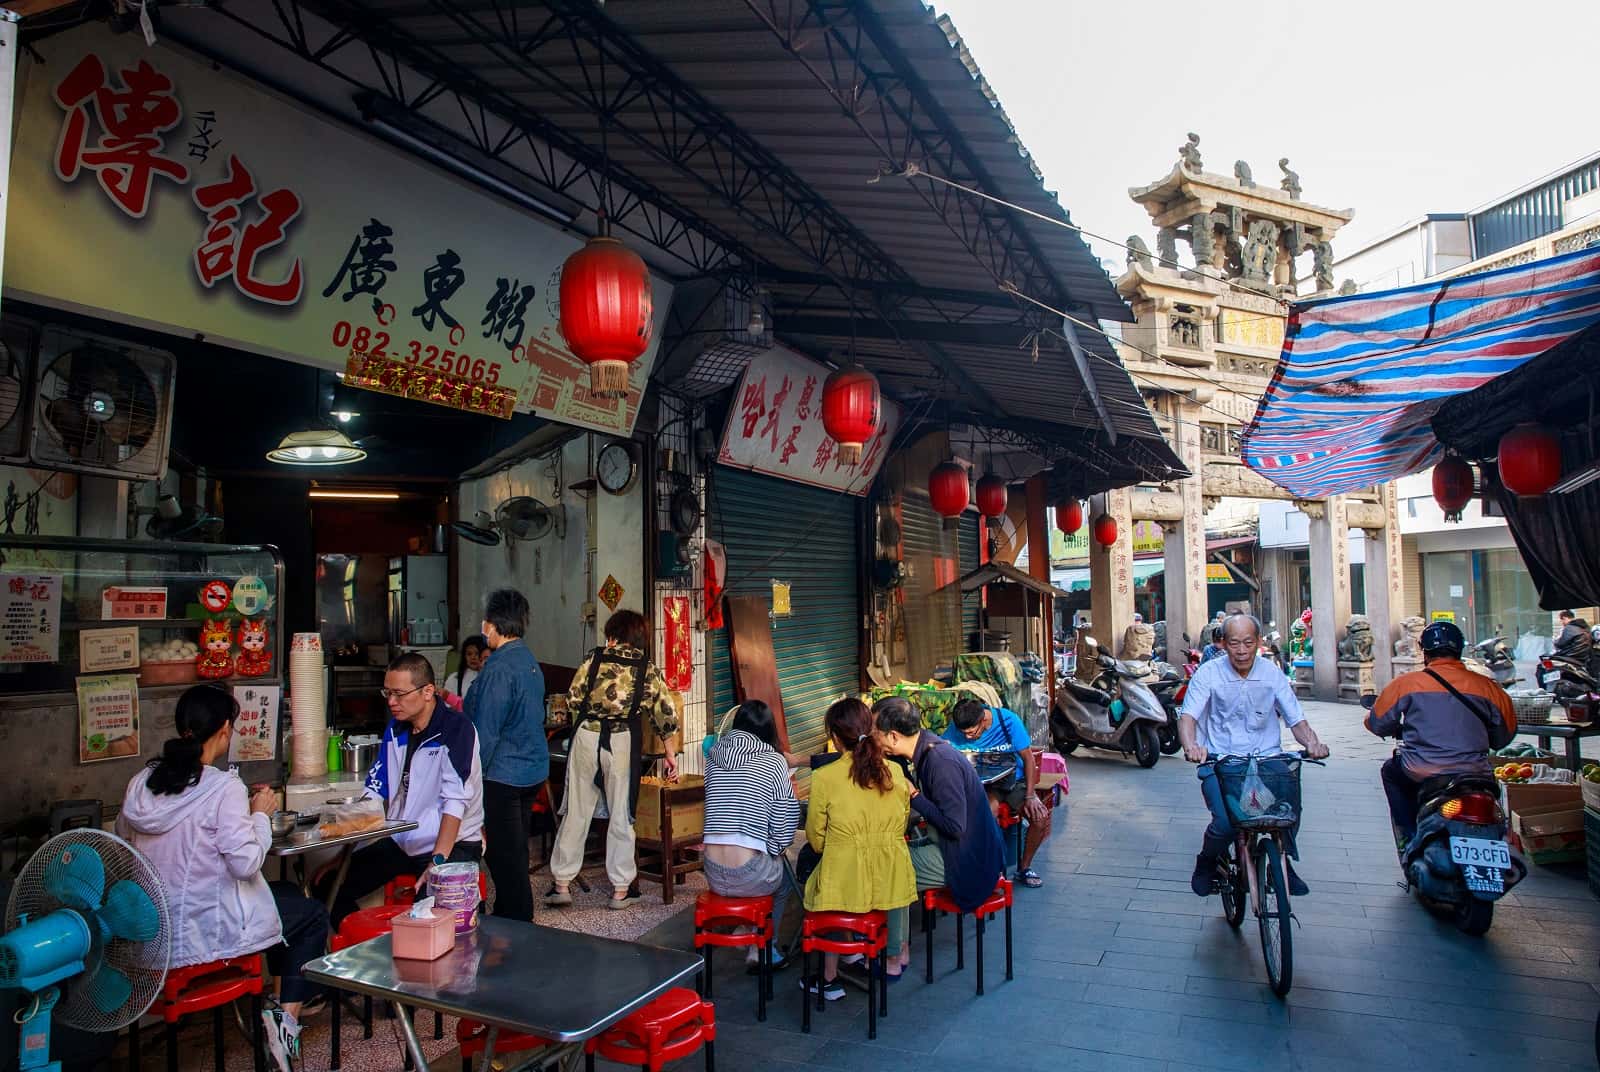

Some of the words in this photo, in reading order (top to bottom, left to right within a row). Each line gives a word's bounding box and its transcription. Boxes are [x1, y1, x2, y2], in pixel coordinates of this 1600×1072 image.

[56, 53, 302, 305] 傳記
[322, 218, 535, 350] 廣東粥
[332, 320, 502, 385] 082-325065
